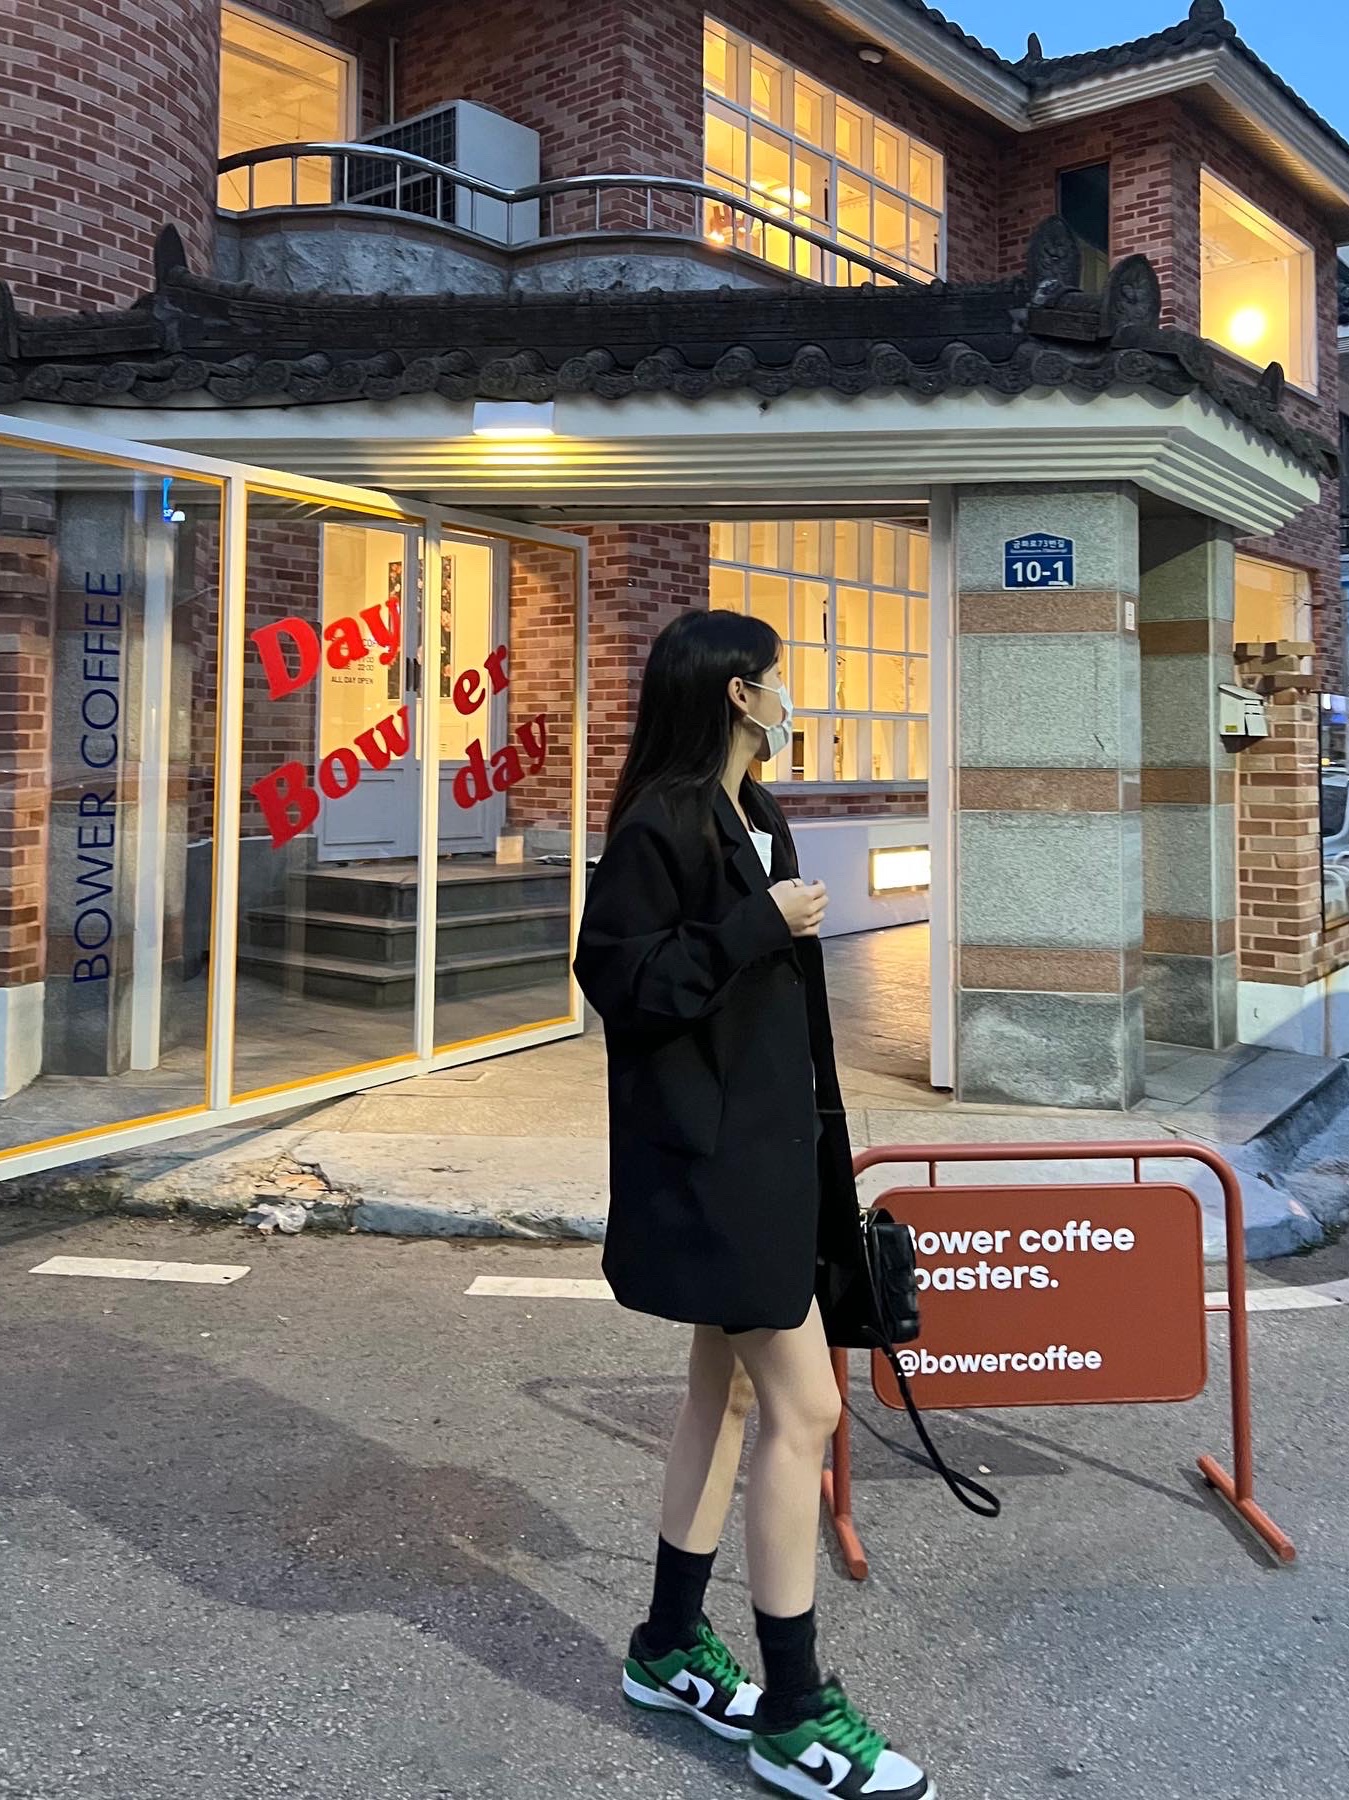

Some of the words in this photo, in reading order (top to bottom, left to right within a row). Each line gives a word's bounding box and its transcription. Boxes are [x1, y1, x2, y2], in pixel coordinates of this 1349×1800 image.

[1012, 561, 1064, 582] 10-1
[81, 571, 122, 769] COFFEE
[251, 595, 400, 701] Day
[453, 713, 546, 809] day
[73, 790, 116, 984] BOWER
[1019, 1220, 1135, 1253] coffee
[913, 1261, 1059, 1291] oasters.
[896, 1344, 1102, 1377] @bowercoffee
